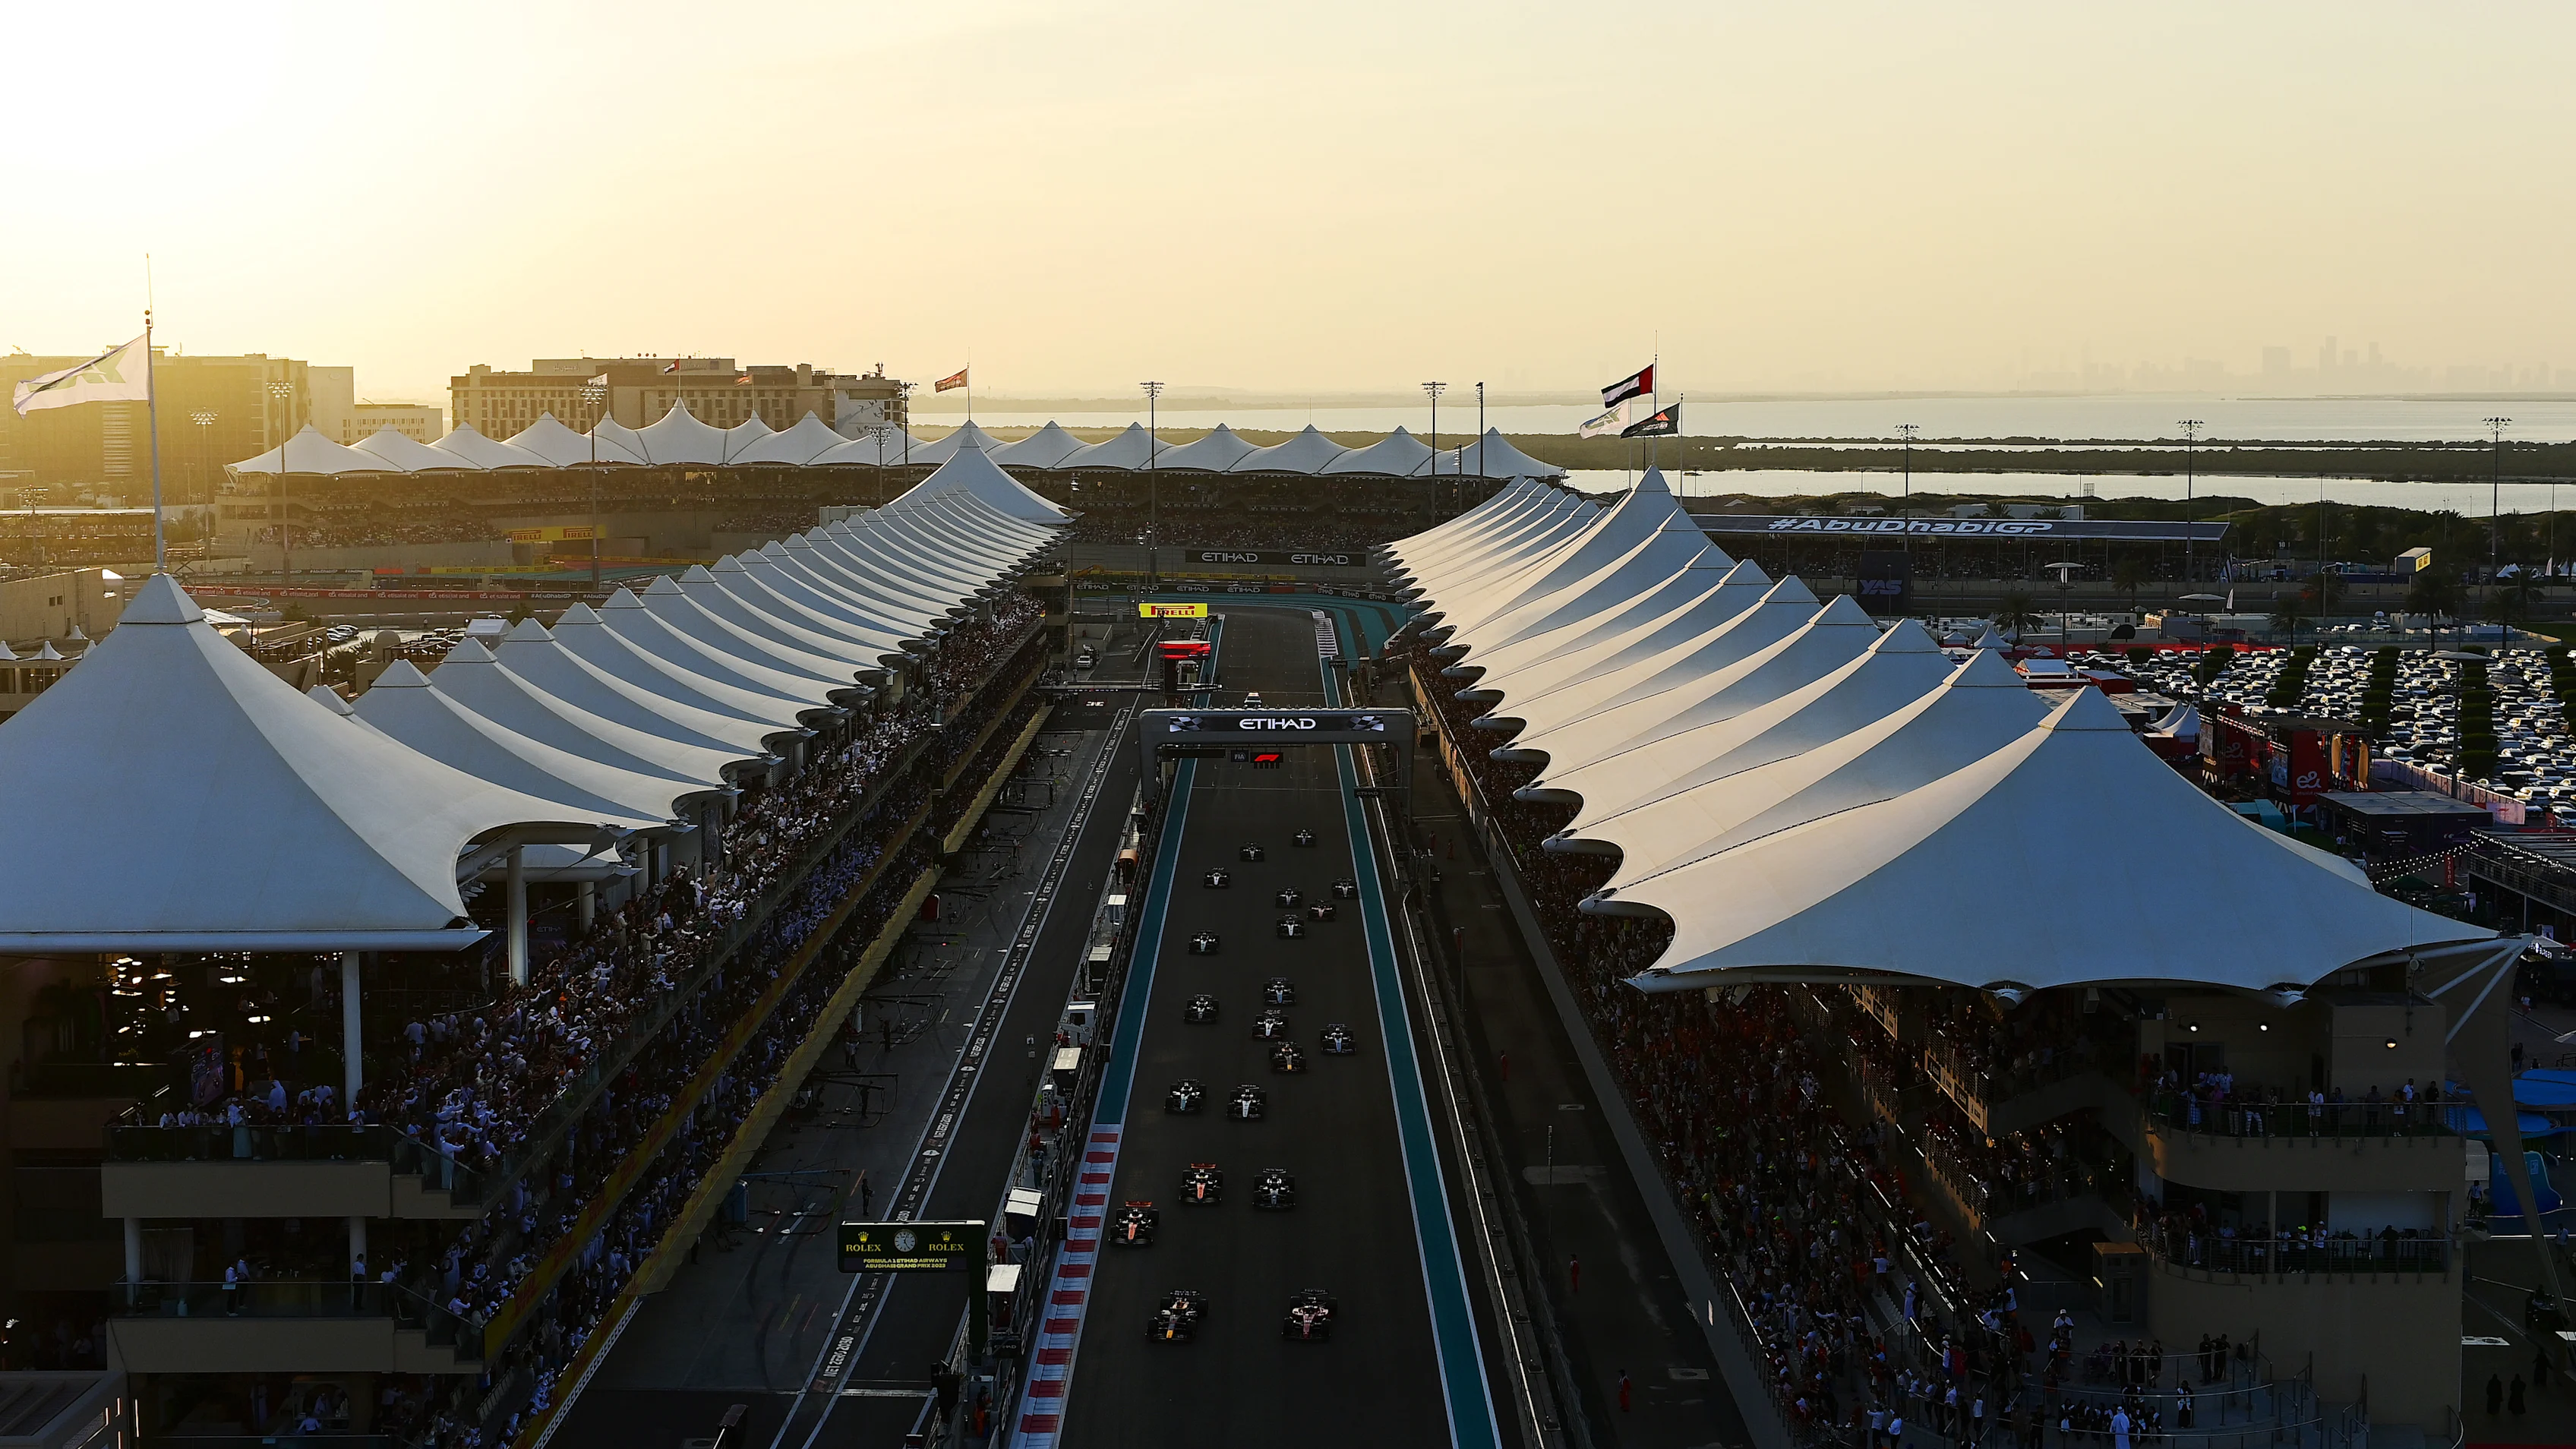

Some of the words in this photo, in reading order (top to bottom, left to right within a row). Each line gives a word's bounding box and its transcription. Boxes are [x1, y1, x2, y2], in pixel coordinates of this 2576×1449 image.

[1769, 518, 2054, 535] #AbuDhabiGP
[563, 528, 593, 538] PIRELL
[1201, 552, 1258, 563] ETIHAD
[1291, 554, 1349, 565] ETIHAD
[1318, 587, 1334, 595] ETIHAD
[1860, 579, 1902, 595] YAS
[1342, 590, 1360, 598] ETIHAD
[1368, 593, 1387, 601] ETIHAD
[1151, 605, 1195, 616] PIRELLI
[1239, 718, 1317, 730] ETIHAD
[845, 1244, 882, 1252] ROLEX
[929, 1243, 964, 1252] ROLEX
